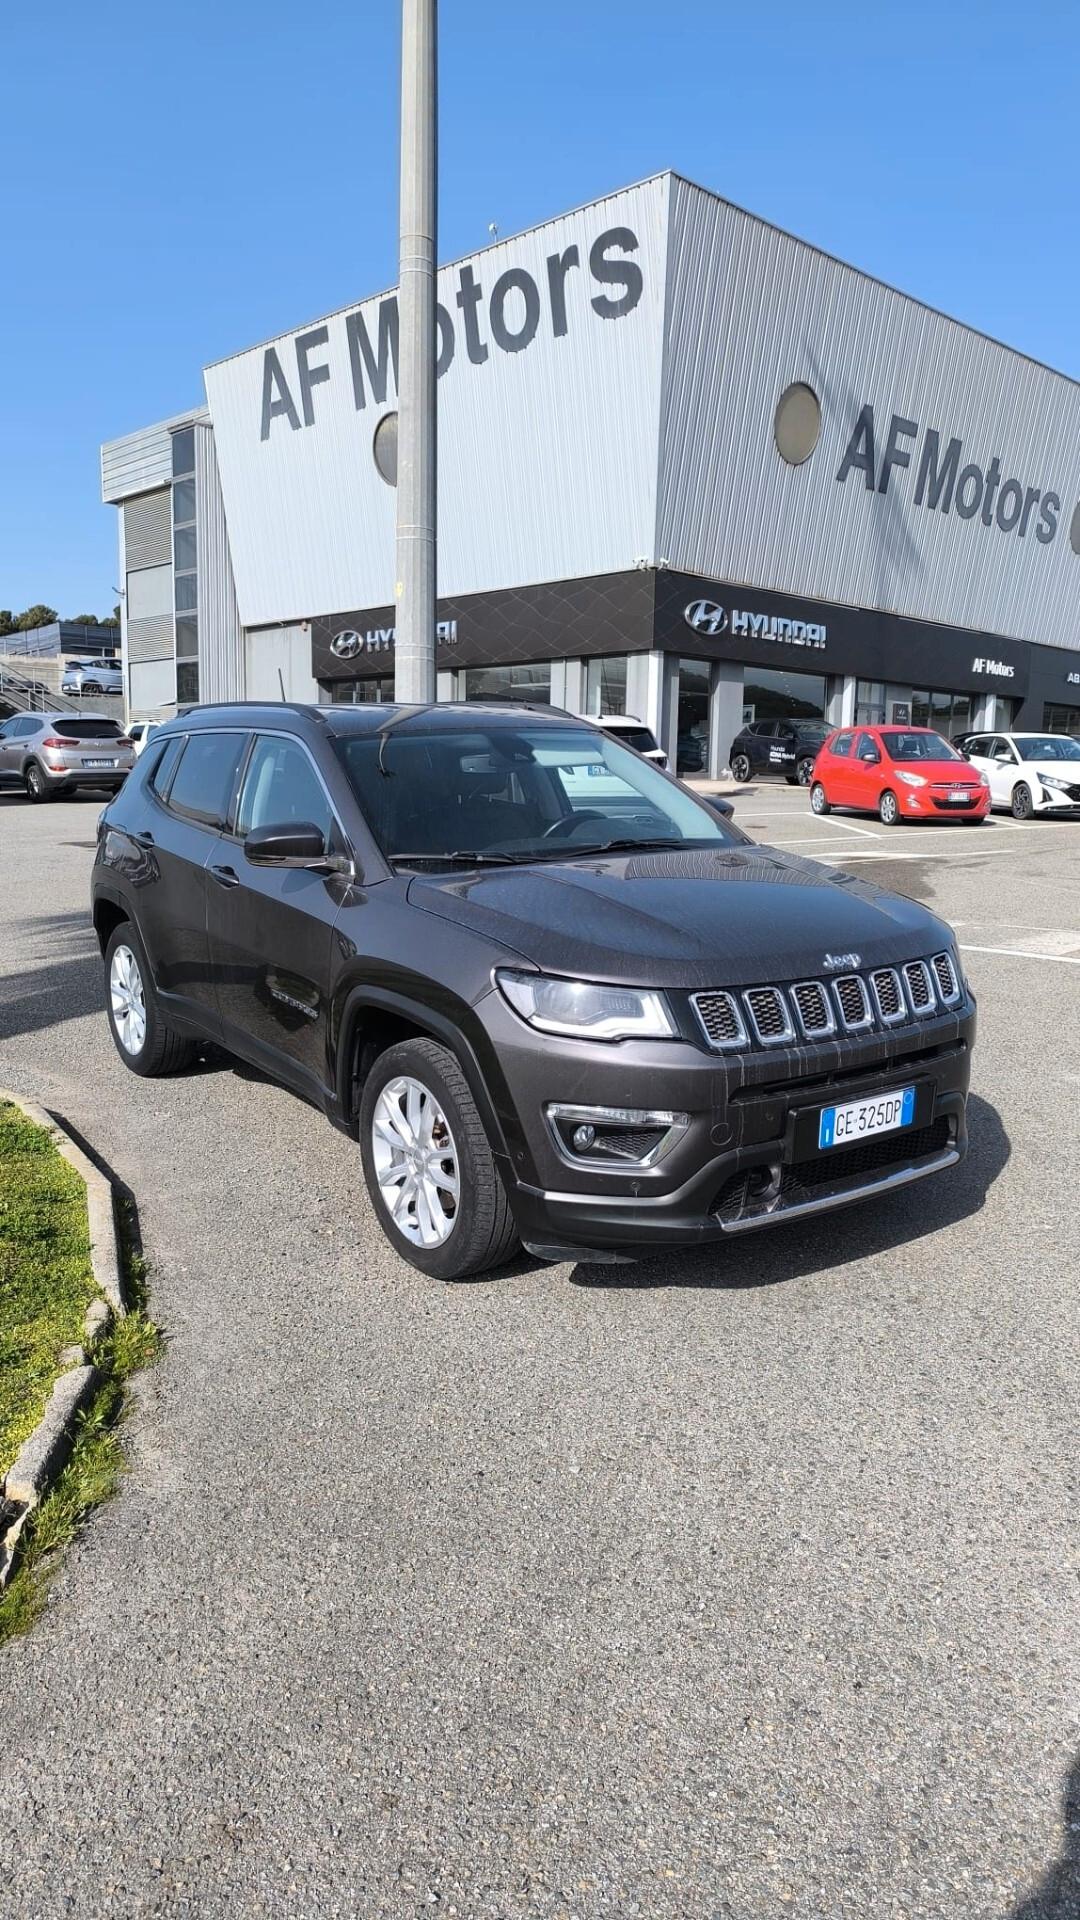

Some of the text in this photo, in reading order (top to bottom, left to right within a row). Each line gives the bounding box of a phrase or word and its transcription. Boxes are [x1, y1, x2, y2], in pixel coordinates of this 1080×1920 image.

[260, 325, 330, 442] AF
[836, 404, 1060, 544] AF Motors
[366, 620, 458, 653] HYAI
[732, 610, 827, 649] HYUNDAI
[972, 658, 1015, 677] AF Motors
[823, 953, 862, 969] Jeep
[836, 1110, 854, 1136] GE
[859, 1100, 902, 1131] 325DP
